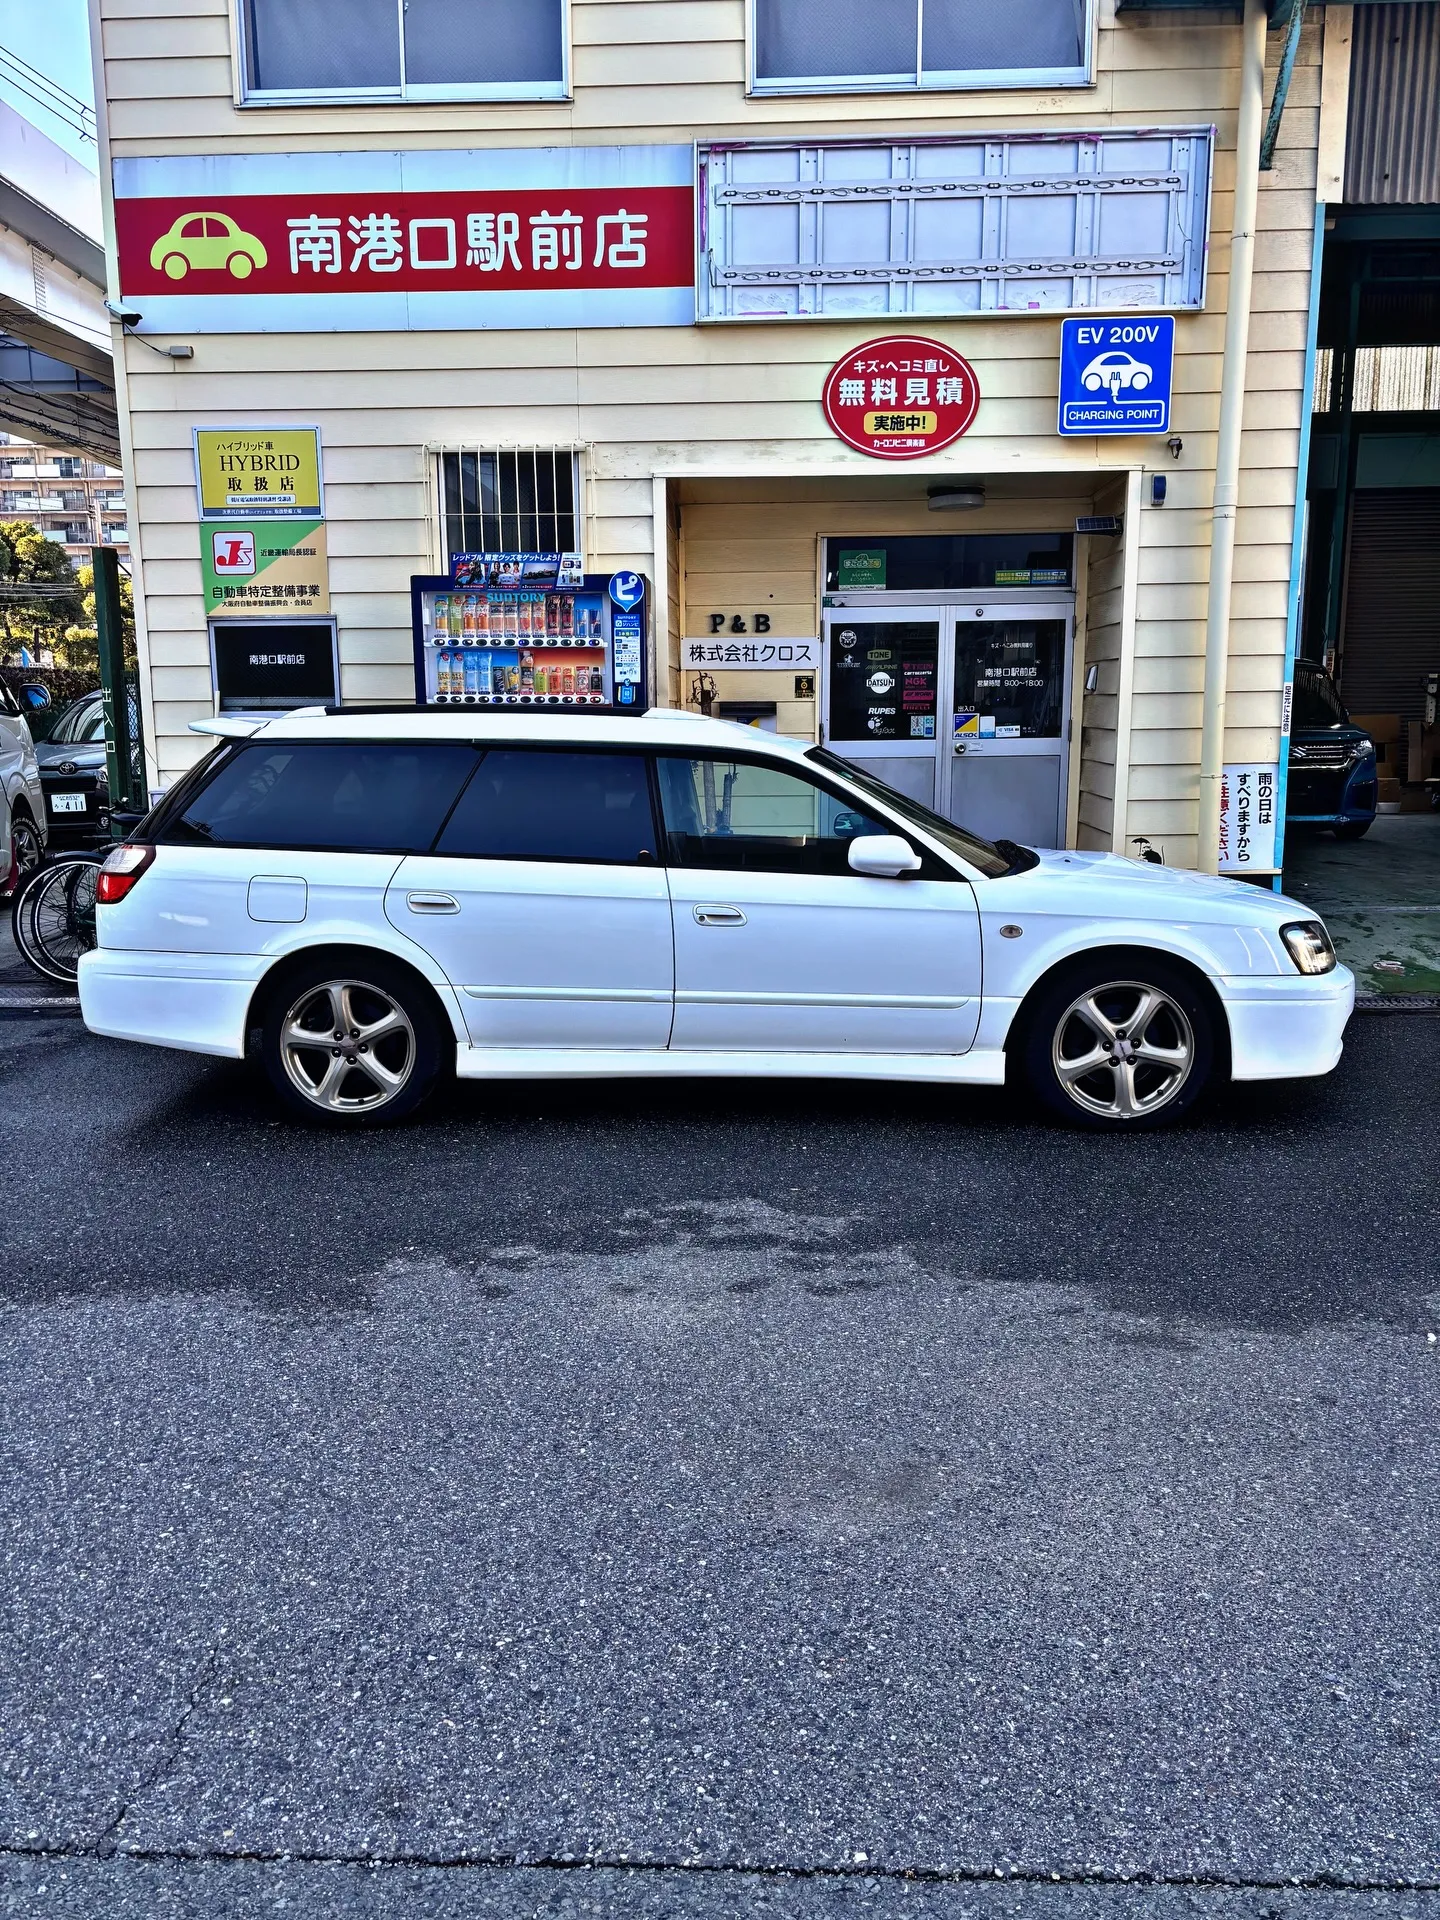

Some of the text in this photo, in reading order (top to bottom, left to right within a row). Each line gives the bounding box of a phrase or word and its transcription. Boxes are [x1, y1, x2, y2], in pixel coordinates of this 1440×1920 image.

[286, 208, 649, 275] 南港口駅前店
[1077, 325, 1159, 344] EV 200V
[853, 358, 950, 373] キズ・ヘコミ直し
[838, 376, 964, 406] 無料見積
[873, 413, 926, 431] 実施中!
[1068, 408, 1161, 421] CHARGING POINT
[216, 441, 275, 452] ハイブリッド車
[219, 454, 300, 472] HYBRID
[227, 476, 295, 492] 取扱店
[452, 553, 482, 561] レッドブル
[212, 584, 321, 599] 自動車特定整備事業
[616, 574, 638, 601] ピ
[486, 592, 546, 603] SUNTORY
[249, 654, 306, 665] 南港口駅前店
[689, 644, 812, 662] 株式会社クロス
[869, 651, 890, 659] TONE
[984, 667, 1037, 677] 南港口駅前店
[867, 679, 895, 687] DATSUN
[905, 677, 928, 685] NGK
[868, 707, 896, 715] RUPES
[102, 686, 116, 753] 出入口
[1257, 772, 1273, 824] 雨の日は
[1236, 773, 1251, 862] すべりますから
